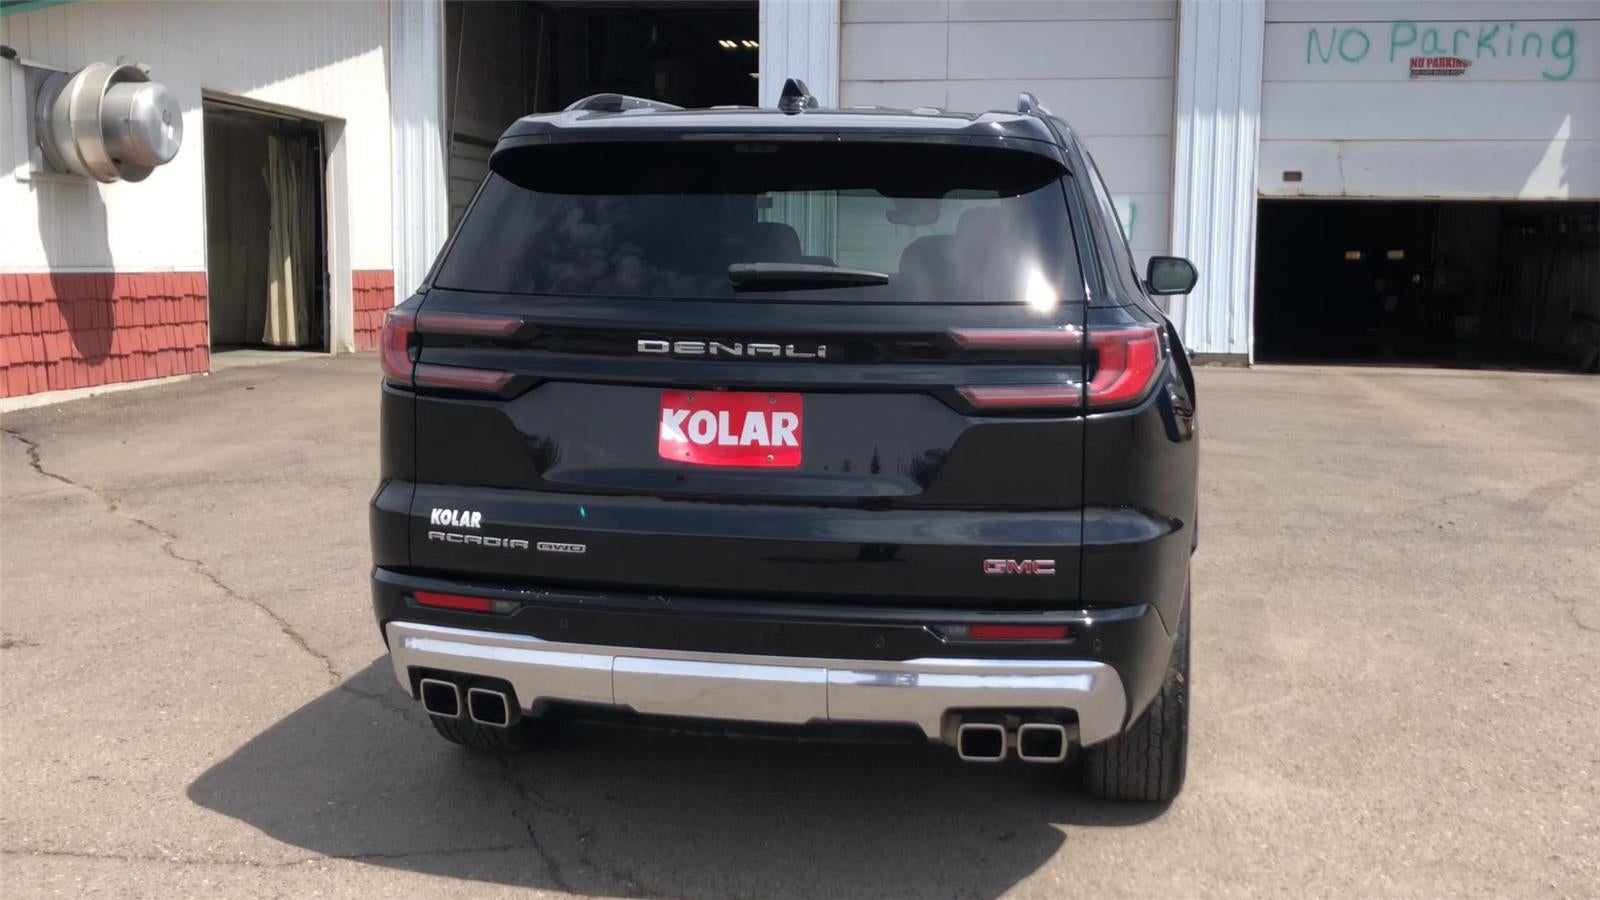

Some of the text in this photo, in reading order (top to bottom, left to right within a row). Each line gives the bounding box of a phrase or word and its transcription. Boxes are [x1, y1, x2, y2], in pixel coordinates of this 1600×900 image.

[1410, 57, 1424, 68] NO
[637, 339, 827, 358] DENALI
[660, 408, 800, 447] KOLAR
[430, 508, 482, 528] KOLAR
[428, 530, 586, 553] ACADIA AWD
[983, 559, 1056, 575] GMC
